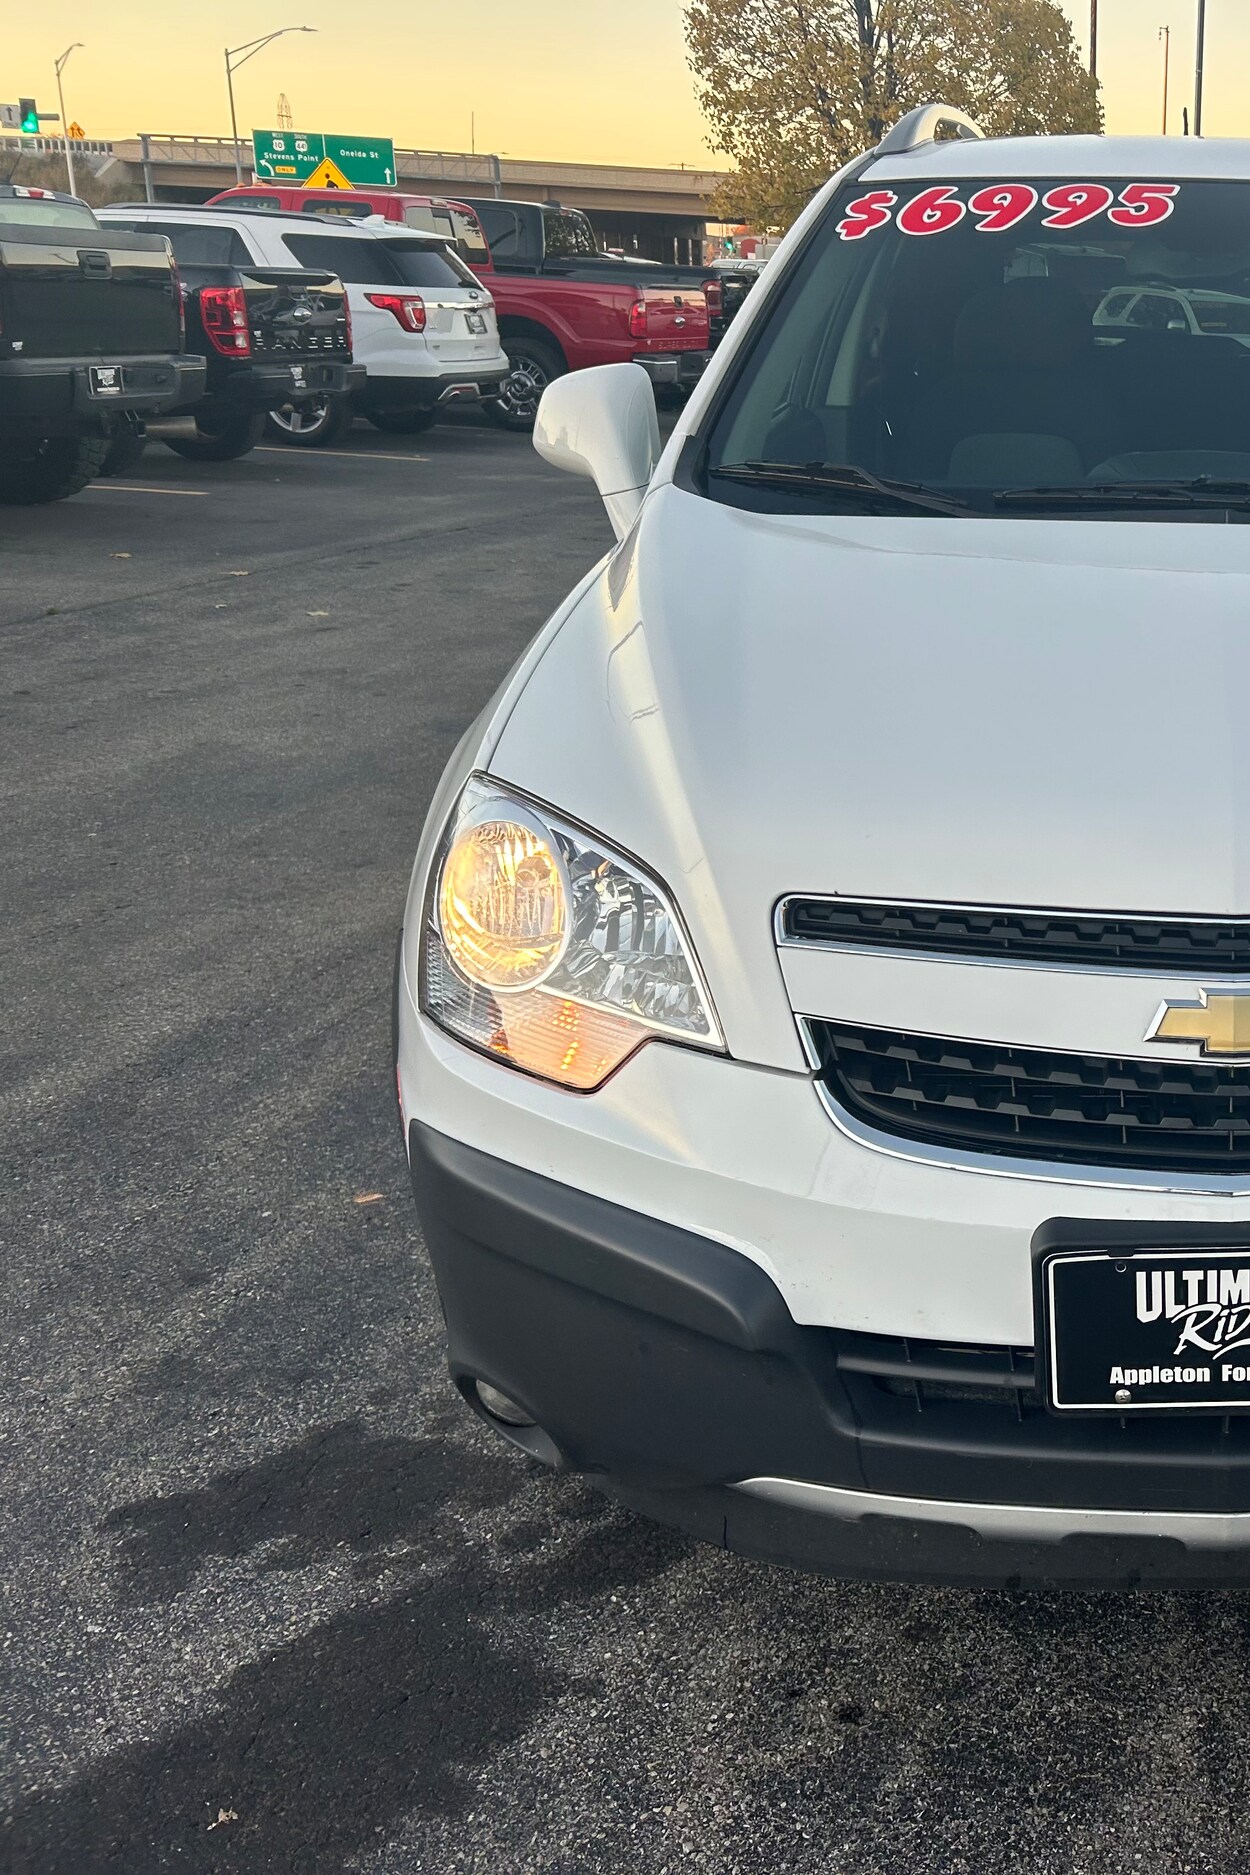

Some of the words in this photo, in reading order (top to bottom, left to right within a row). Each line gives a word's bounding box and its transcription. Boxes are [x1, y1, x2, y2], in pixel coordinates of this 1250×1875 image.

[275, 141, 283, 149] 10
[263, 152, 295, 161] Stevens
[297, 154, 319, 162] Point
[340, 149, 367, 158] Oneida
[370, 151, 379, 159] St
[836, 183, 1180, 240] $6995
[1110, 1366, 1211, 1386] Appleton
